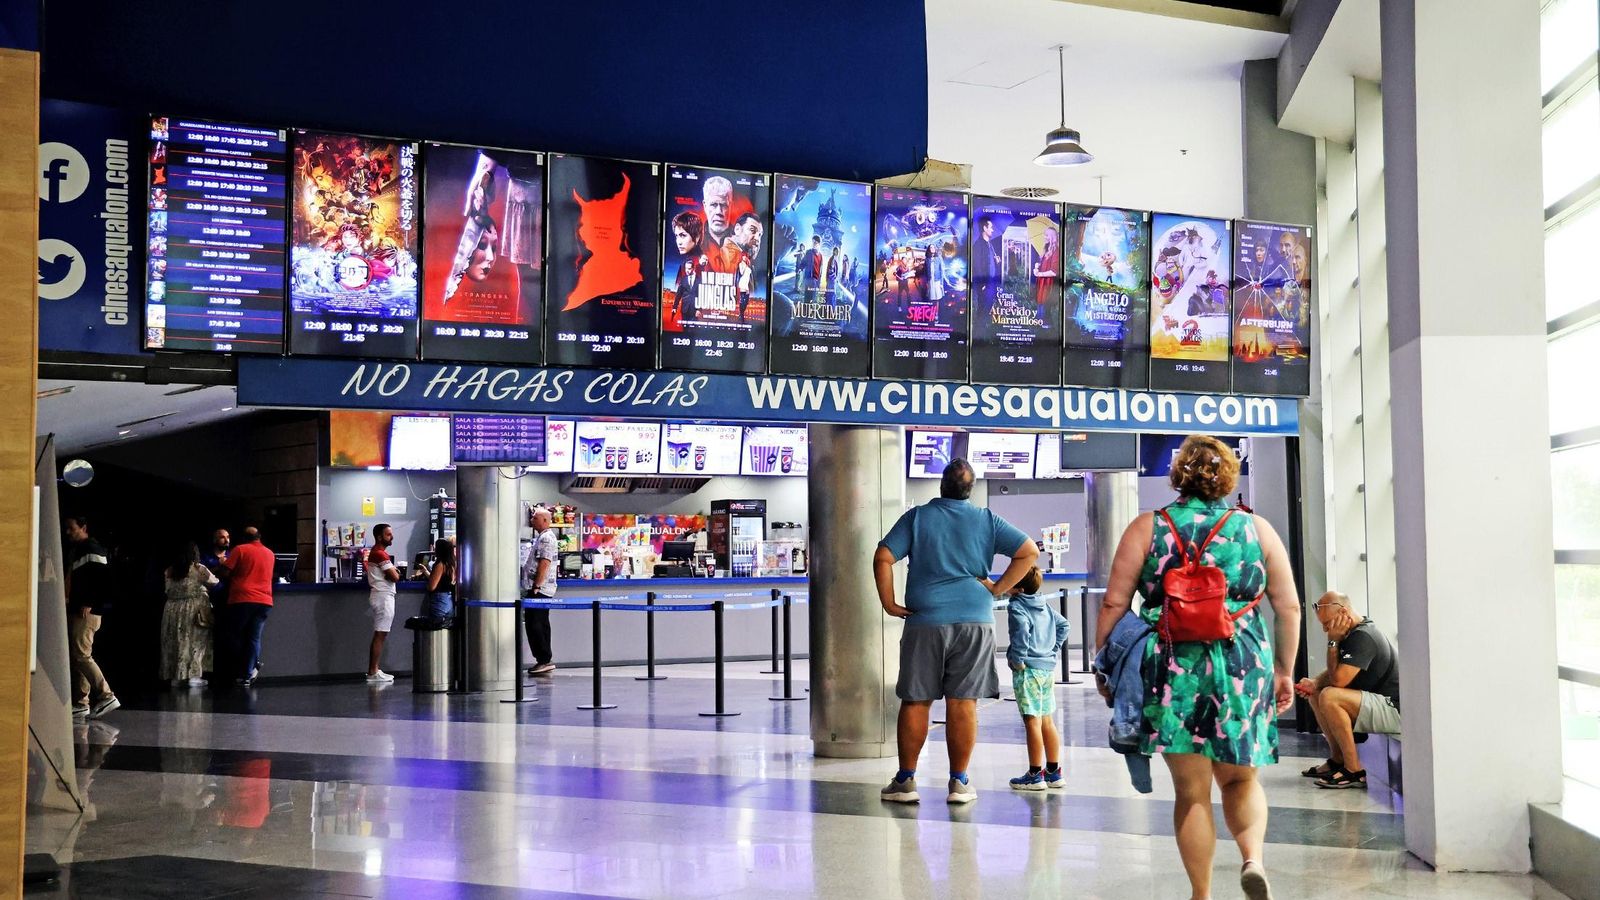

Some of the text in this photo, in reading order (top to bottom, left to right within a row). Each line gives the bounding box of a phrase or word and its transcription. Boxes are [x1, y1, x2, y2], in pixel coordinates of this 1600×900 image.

[100, 138, 133, 326] cinesaqualon.com
[695, 284, 736, 311] JUNGLAS
[1085, 289, 1128, 308] ANGELO
[998, 299, 1017, 308] Viaje
[990, 306, 1037, 318] Atrevido y
[1084, 311, 1127, 321] MISTERIOSO
[992, 315, 1043, 326] Maravilloso
[1240, 319, 1293, 328] AFTERBURN
[304, 321, 326, 330] 12:00
[331, 323, 352, 331] 16:00
[358, 324, 378, 332] 17:45
[344, 334, 365, 342] 21:45
[436, 327, 529, 339] 16:00 18:40 20:30 22:15
[558, 333, 577, 341] 12:00
[581, 334, 600, 342] 16:00
[627, 336, 645, 344] 20:10
[592, 344, 611, 352] 22:00
[341, 364, 709, 407] NO HAGAS COLAS
